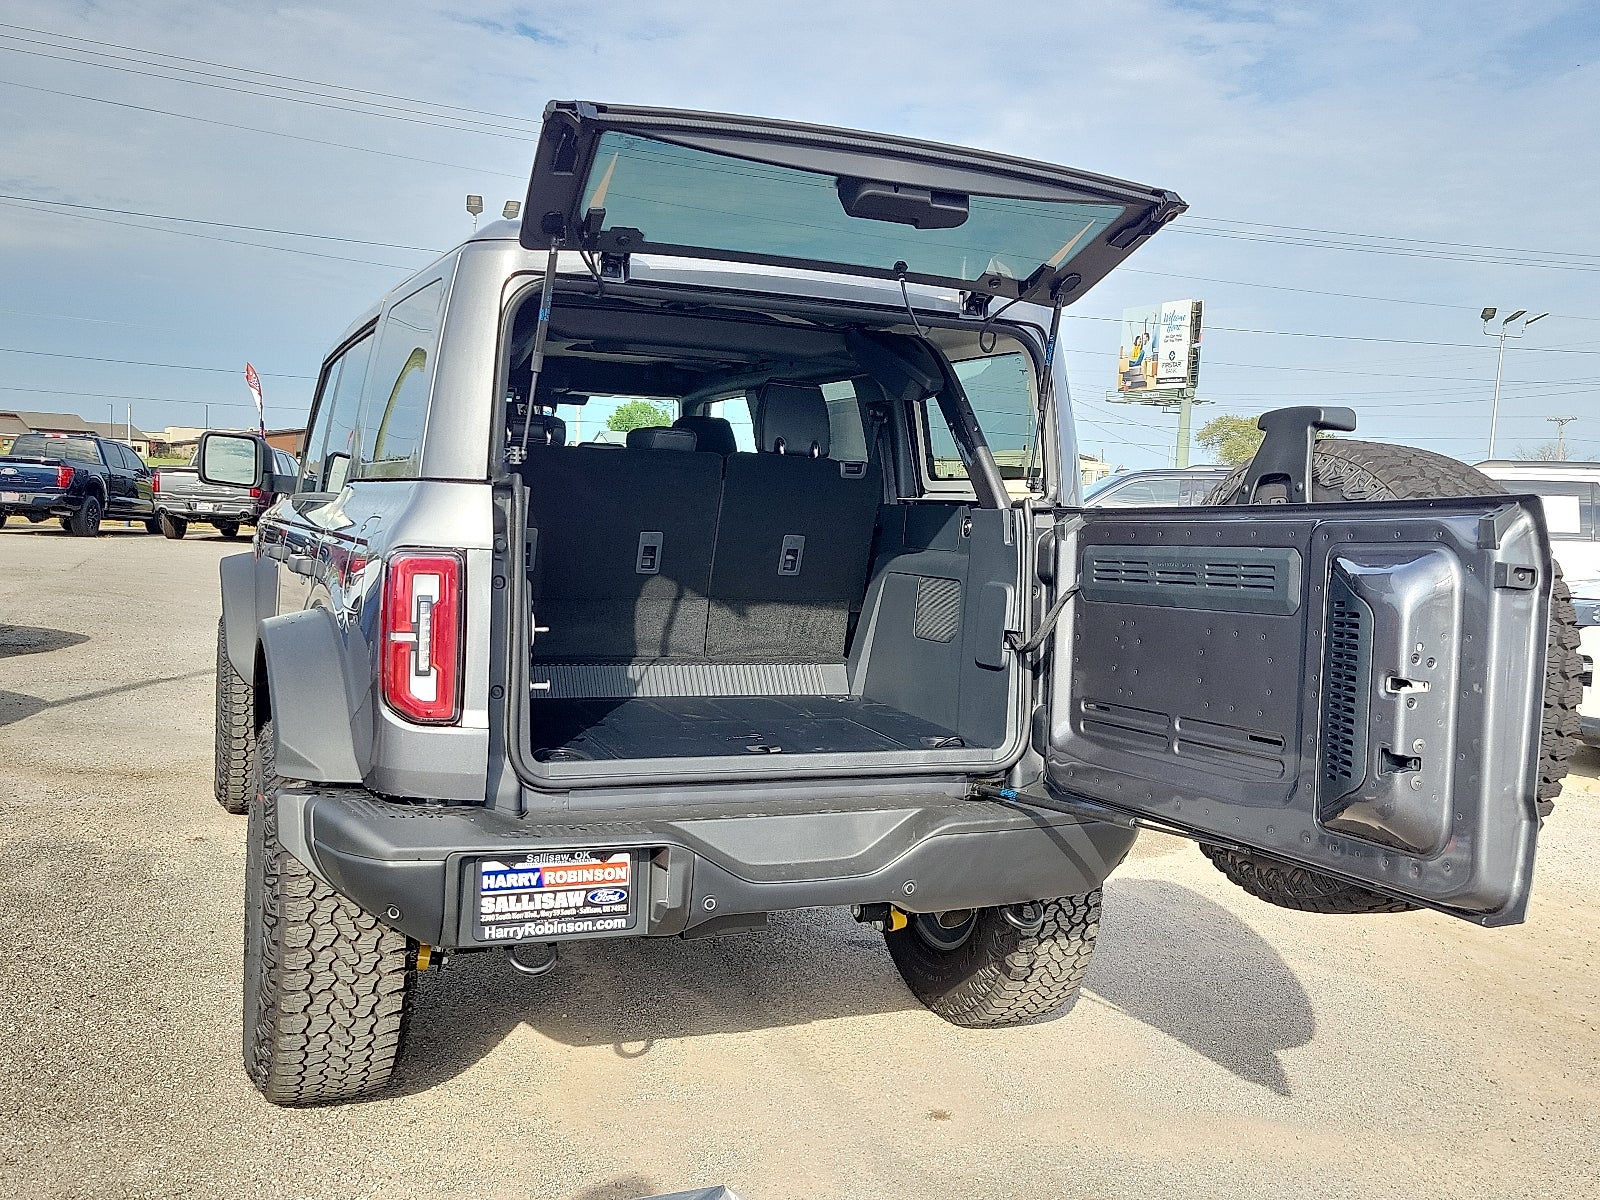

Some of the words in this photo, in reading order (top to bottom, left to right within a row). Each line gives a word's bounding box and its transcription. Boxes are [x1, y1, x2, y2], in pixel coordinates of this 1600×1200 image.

[526, 852, 571, 863] Sallisaw,
[574, 851, 591, 860] OK
[482, 872, 541, 890] HARRY
[544, 867, 628, 885] ROBINSON
[481, 890, 587, 914] SALLISAW
[594, 889, 621, 903] Ford
[560, 907, 576, 915] South
[484, 919, 626, 940] HarryRobinson.com
